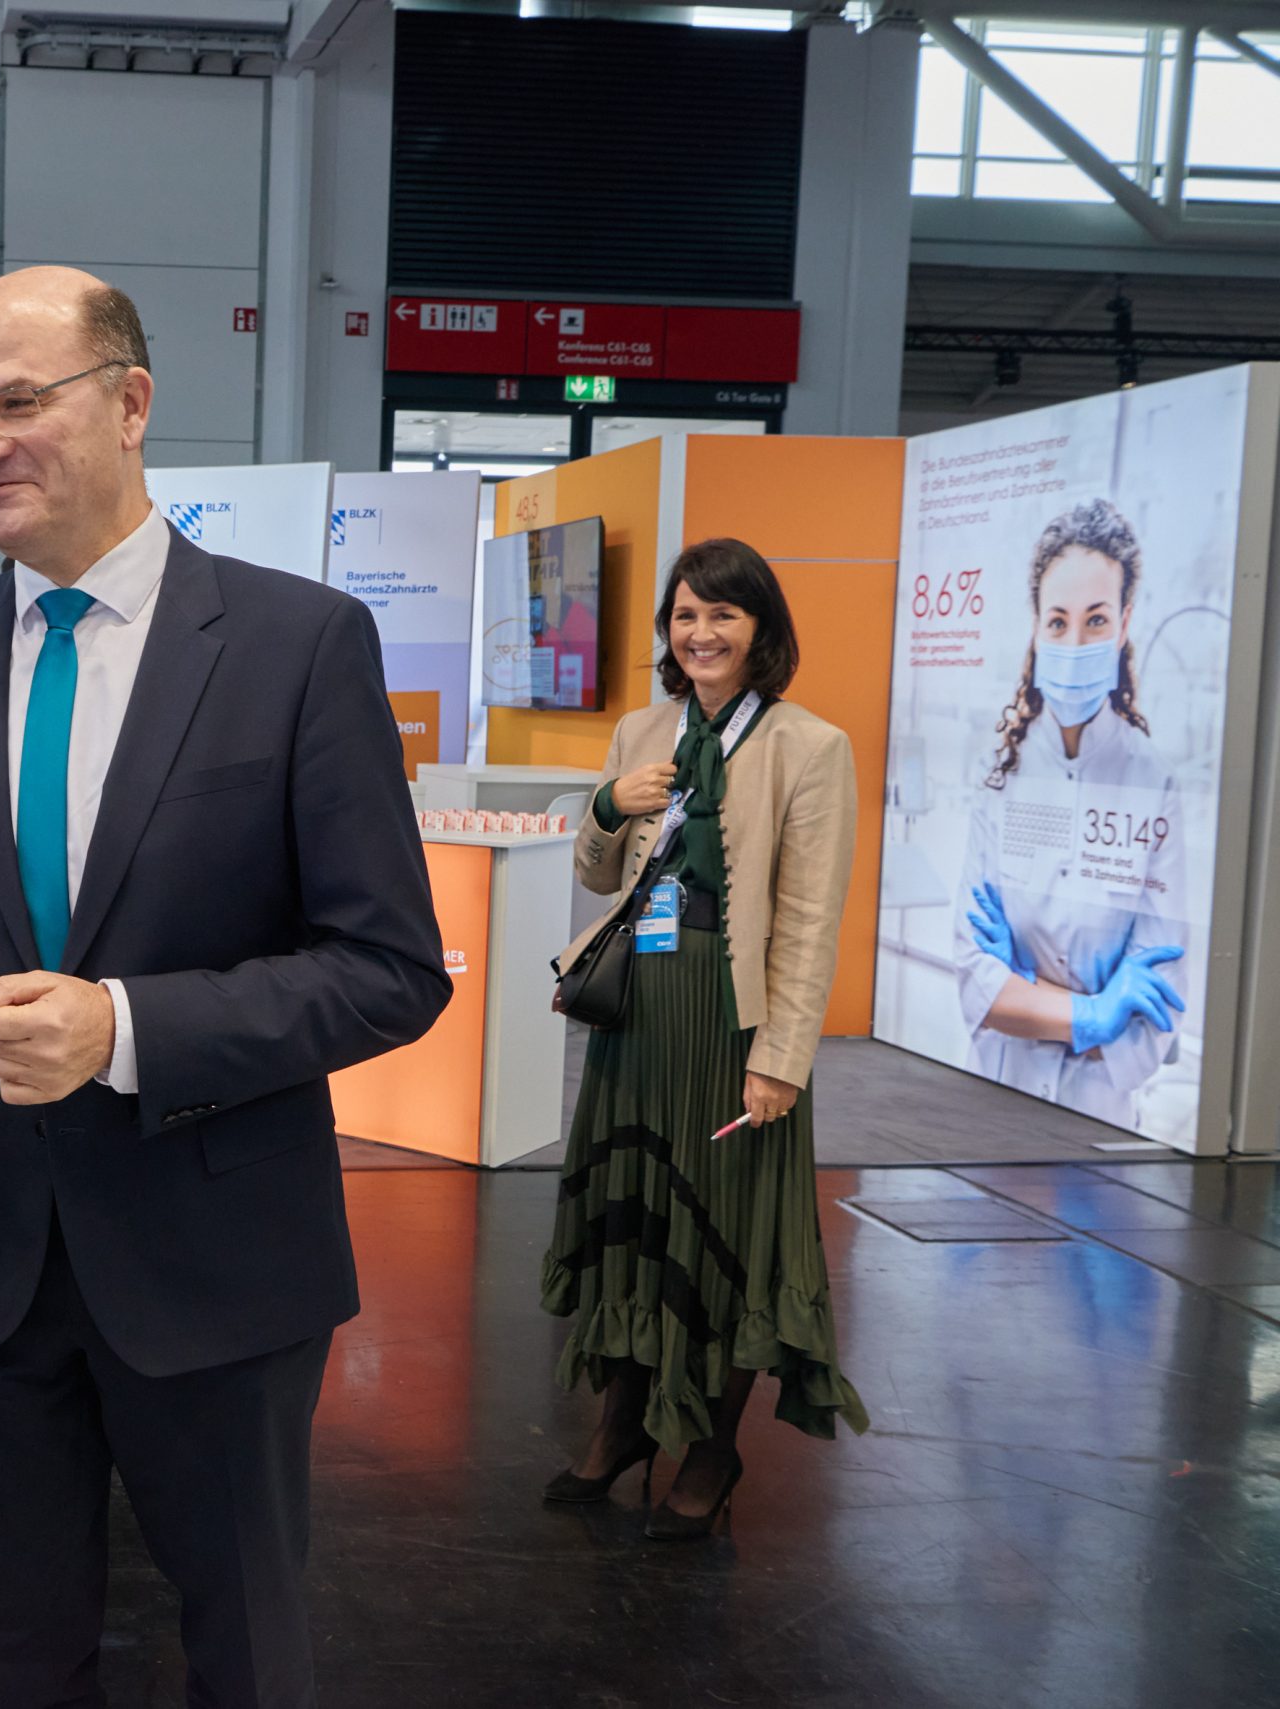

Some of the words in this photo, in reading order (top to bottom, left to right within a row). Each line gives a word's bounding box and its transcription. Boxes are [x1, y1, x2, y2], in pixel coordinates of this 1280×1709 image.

[206, 503, 231, 512] BLZK
[349, 509, 376, 518] BLZK
[346, 571, 406, 583] Bayerische
[346, 584, 438, 595] LandesZahnärzte
[912, 568, 984, 620] 8,6%
[364, 599, 389, 608] mer
[729, 700, 753, 731] FUTRUE
[1083, 808, 1169, 852] 35.149
